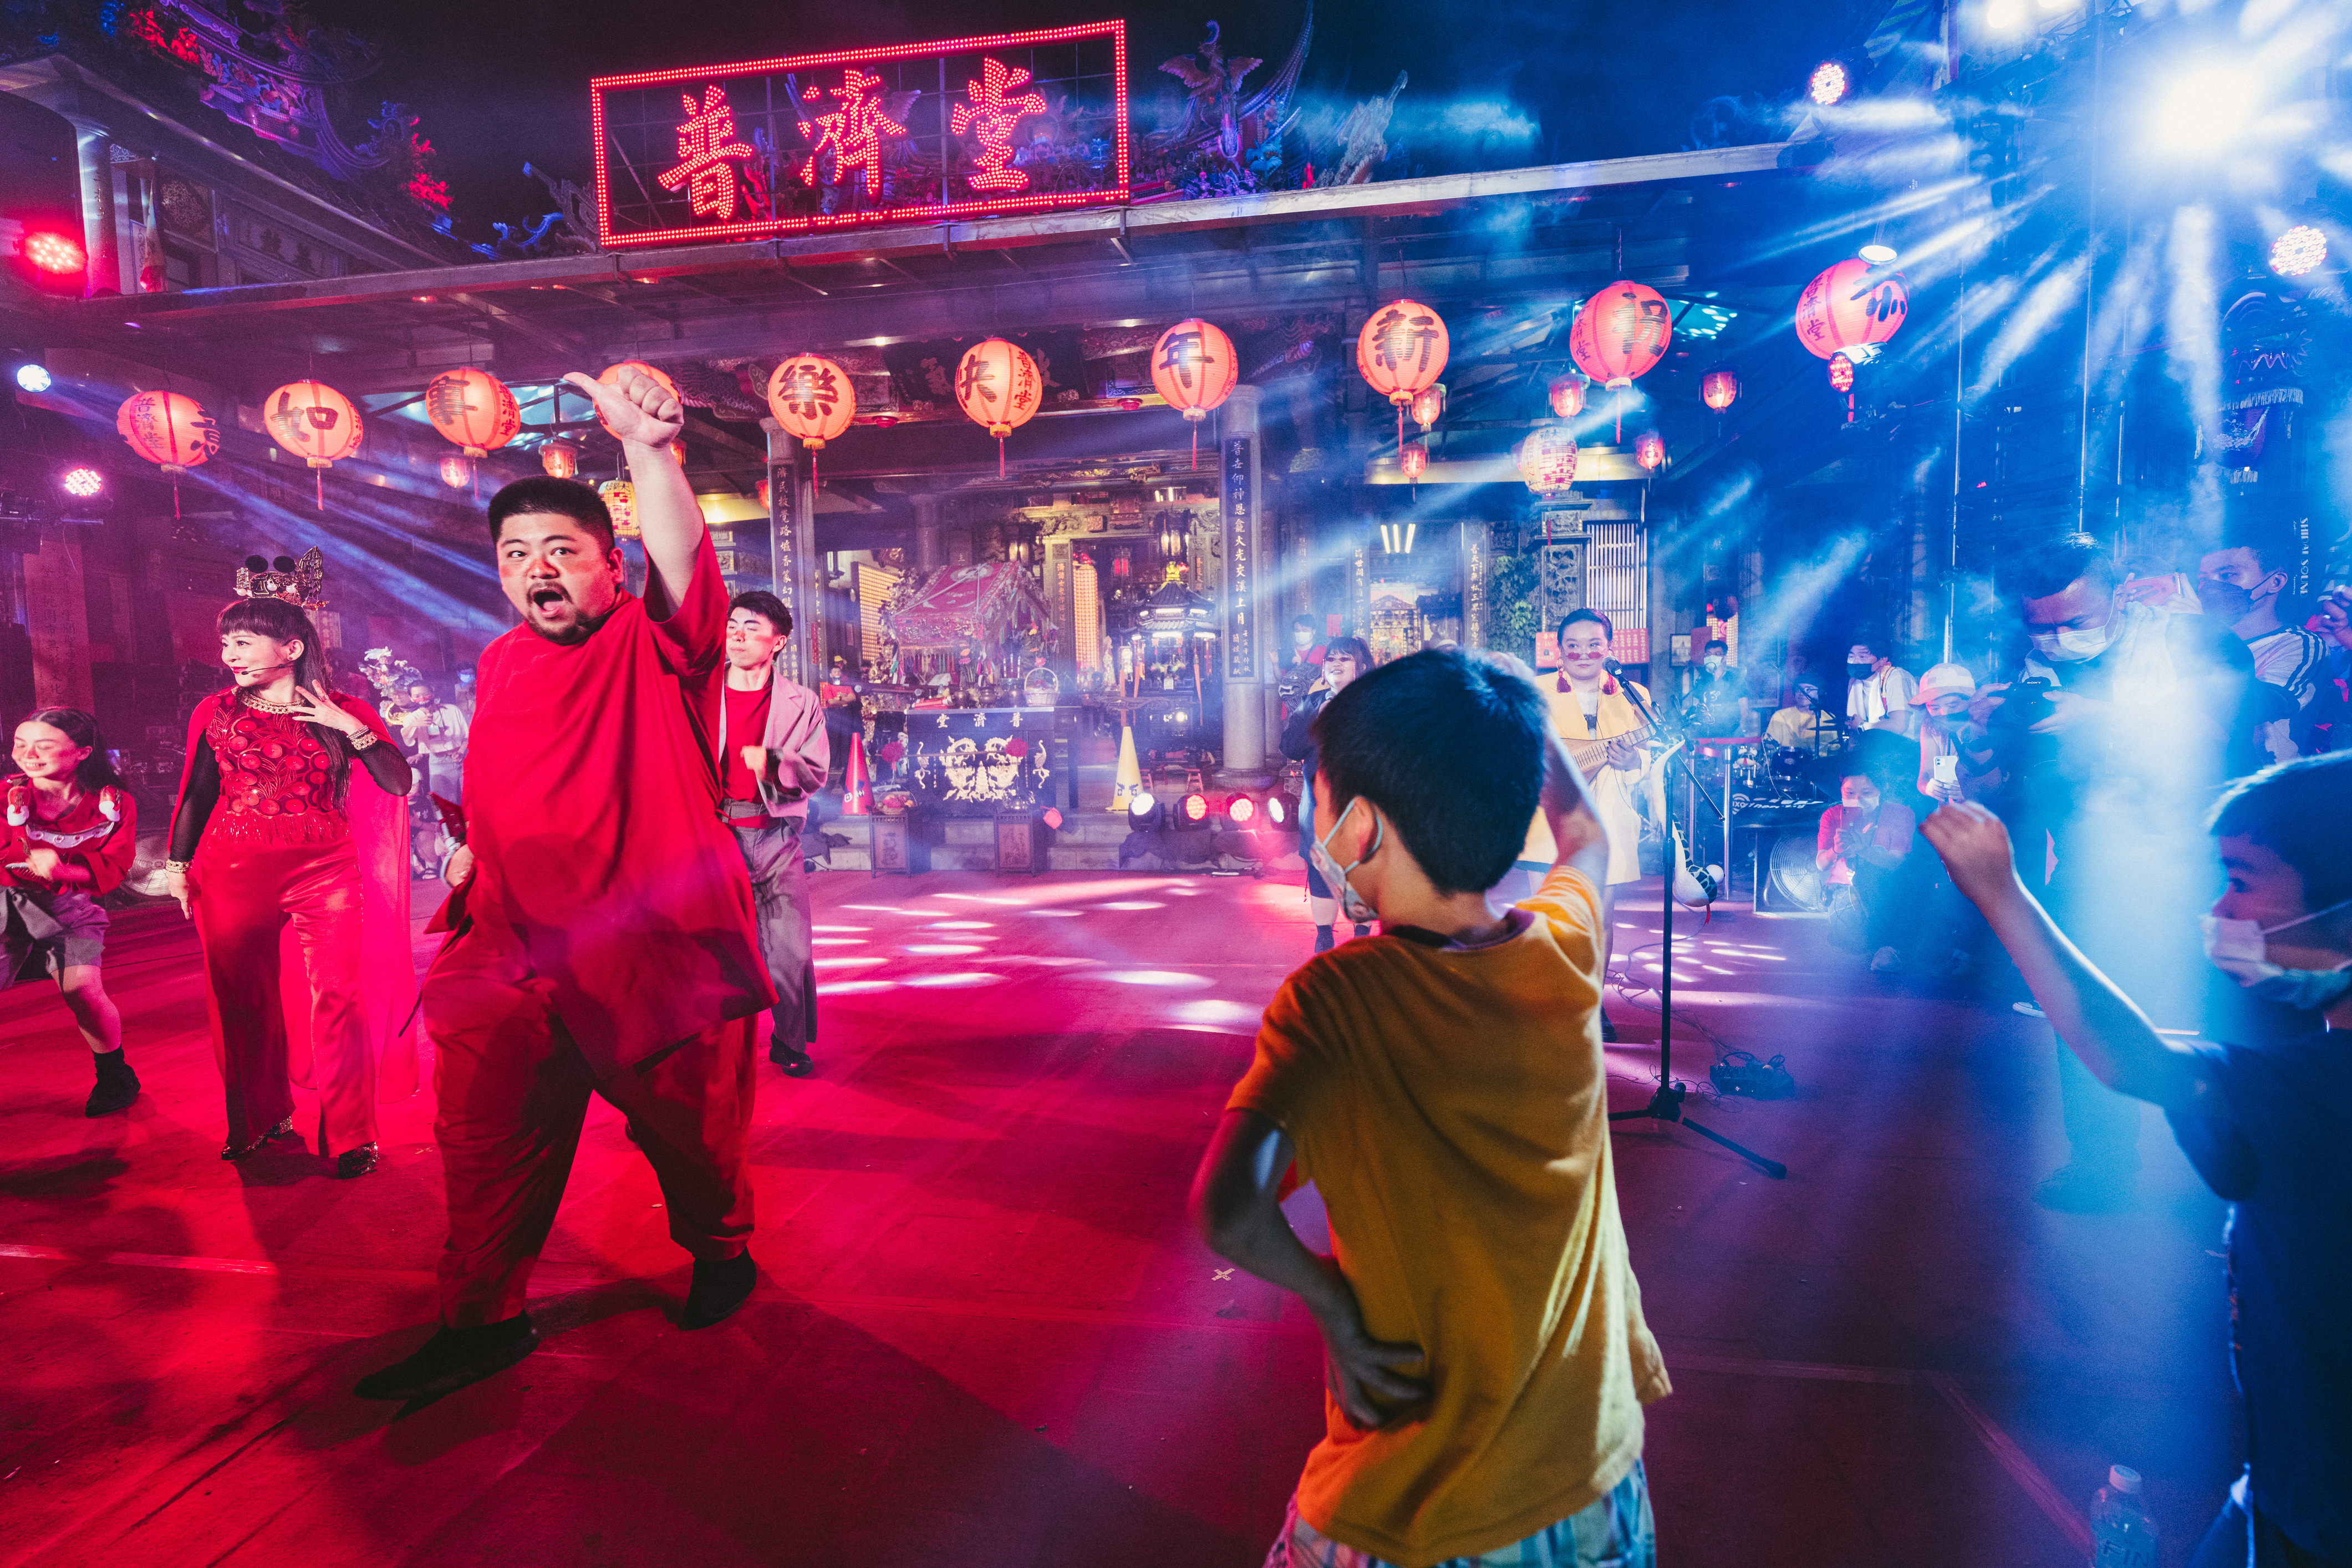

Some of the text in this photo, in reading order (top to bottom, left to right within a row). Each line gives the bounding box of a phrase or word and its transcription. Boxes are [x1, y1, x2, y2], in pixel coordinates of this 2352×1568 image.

[656, 55, 1048, 221] 普濟堂
[1612, 292, 1669, 358] 祝
[1801, 274, 1825, 341] 普濟堂
[1158, 331, 1215, 389] 年
[1371, 309, 1440, 373] 新
[776, 364, 839, 420] 樂
[1013, 350, 1036, 411] 普濟堂
[134, 396, 164, 449] 普濟堂
[270, 391, 339, 442] 如
[2299, 517, 2309, 598] SHIDAI SOUND
